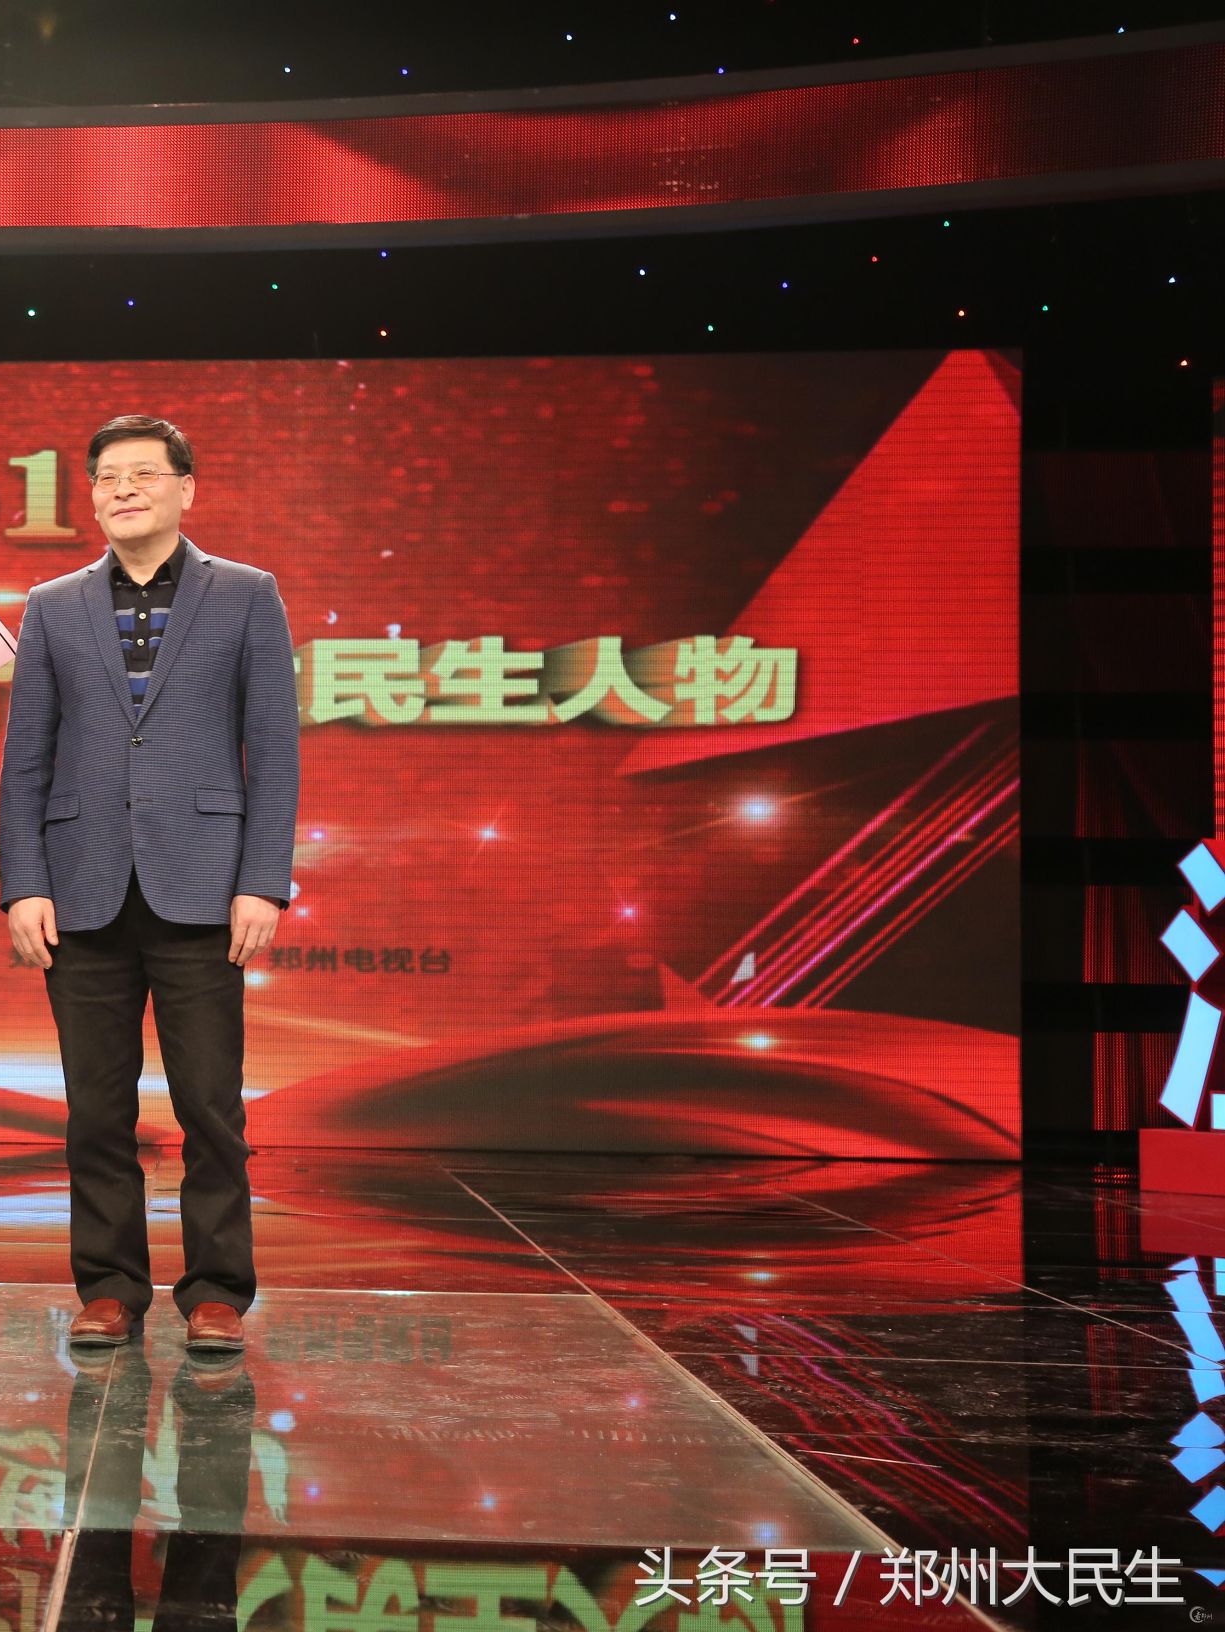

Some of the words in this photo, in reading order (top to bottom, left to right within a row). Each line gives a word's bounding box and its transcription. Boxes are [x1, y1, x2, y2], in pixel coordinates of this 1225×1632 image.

[294, 635, 799, 724] 民生人物
[270, 945, 451, 974] 郑州电视台
